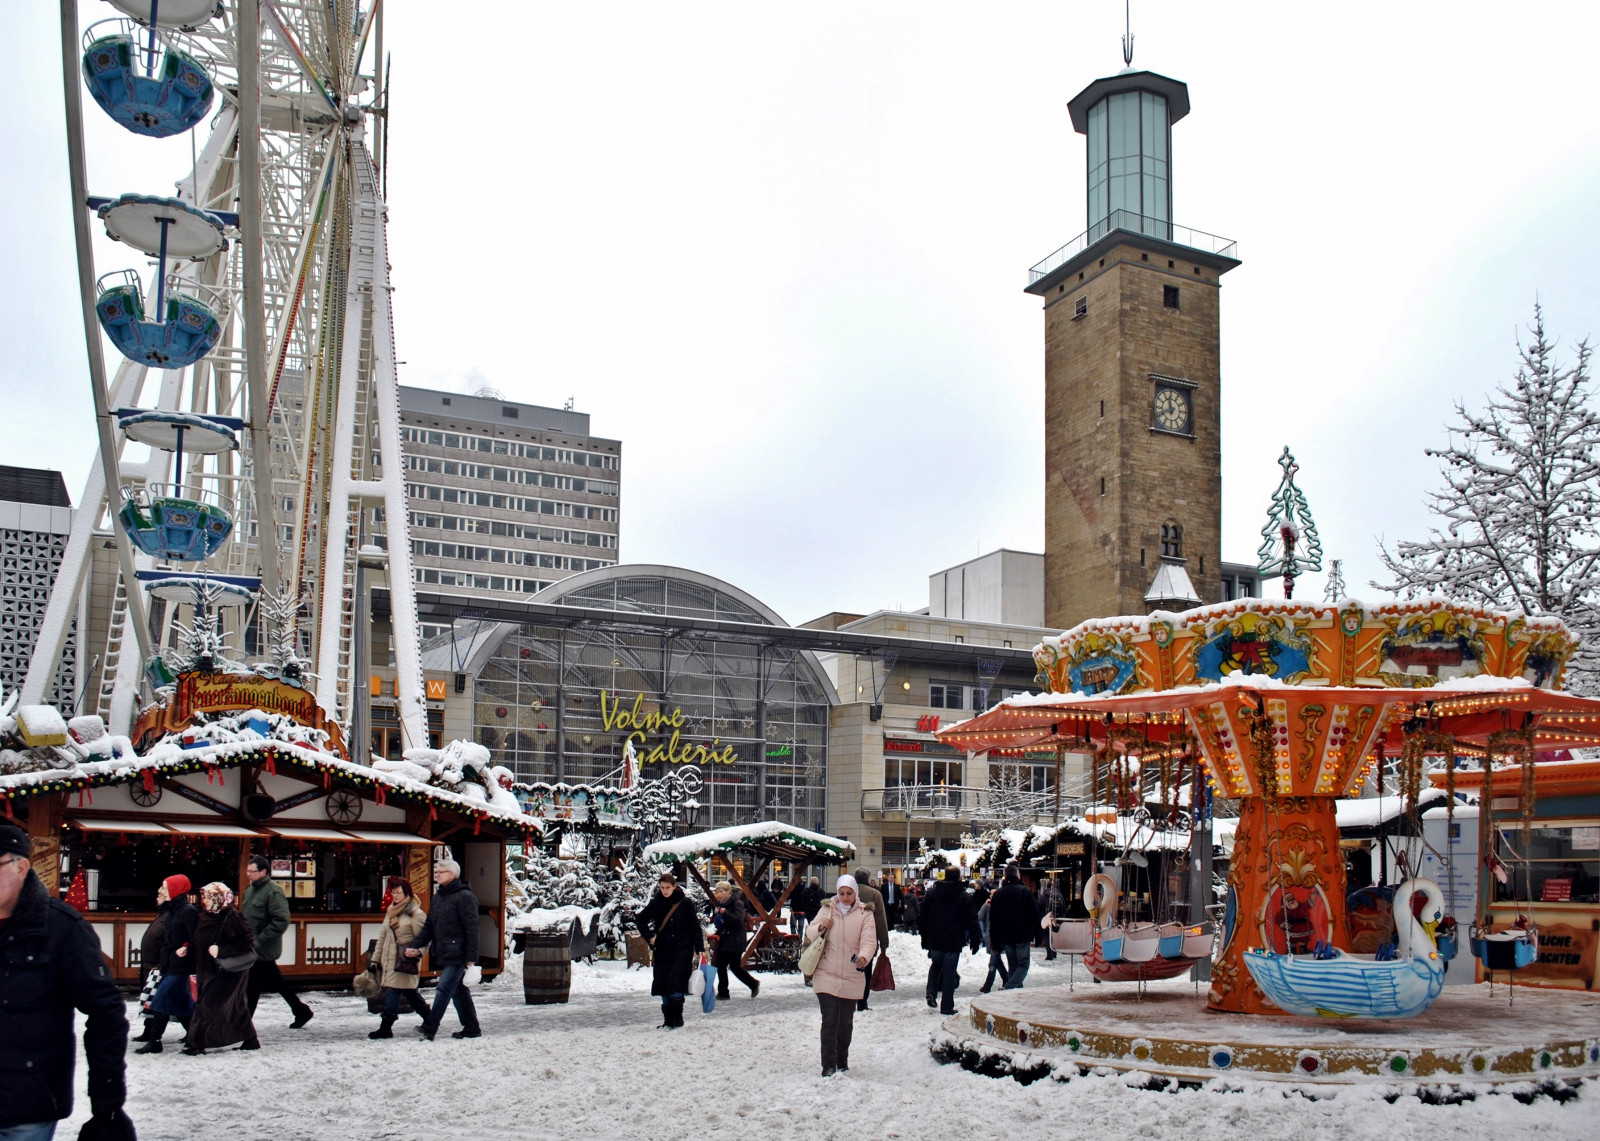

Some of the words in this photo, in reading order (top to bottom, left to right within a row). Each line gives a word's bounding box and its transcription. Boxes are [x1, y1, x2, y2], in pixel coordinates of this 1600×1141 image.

[428, 680, 446, 694] W
[601, 689, 685, 732] Volme
[916, 714, 941, 733] H&M
[622, 729, 739, 771] Galerie
[1538, 935, 1572, 947] LICHE
[1536, 952, 1581, 965] ACHTEN
